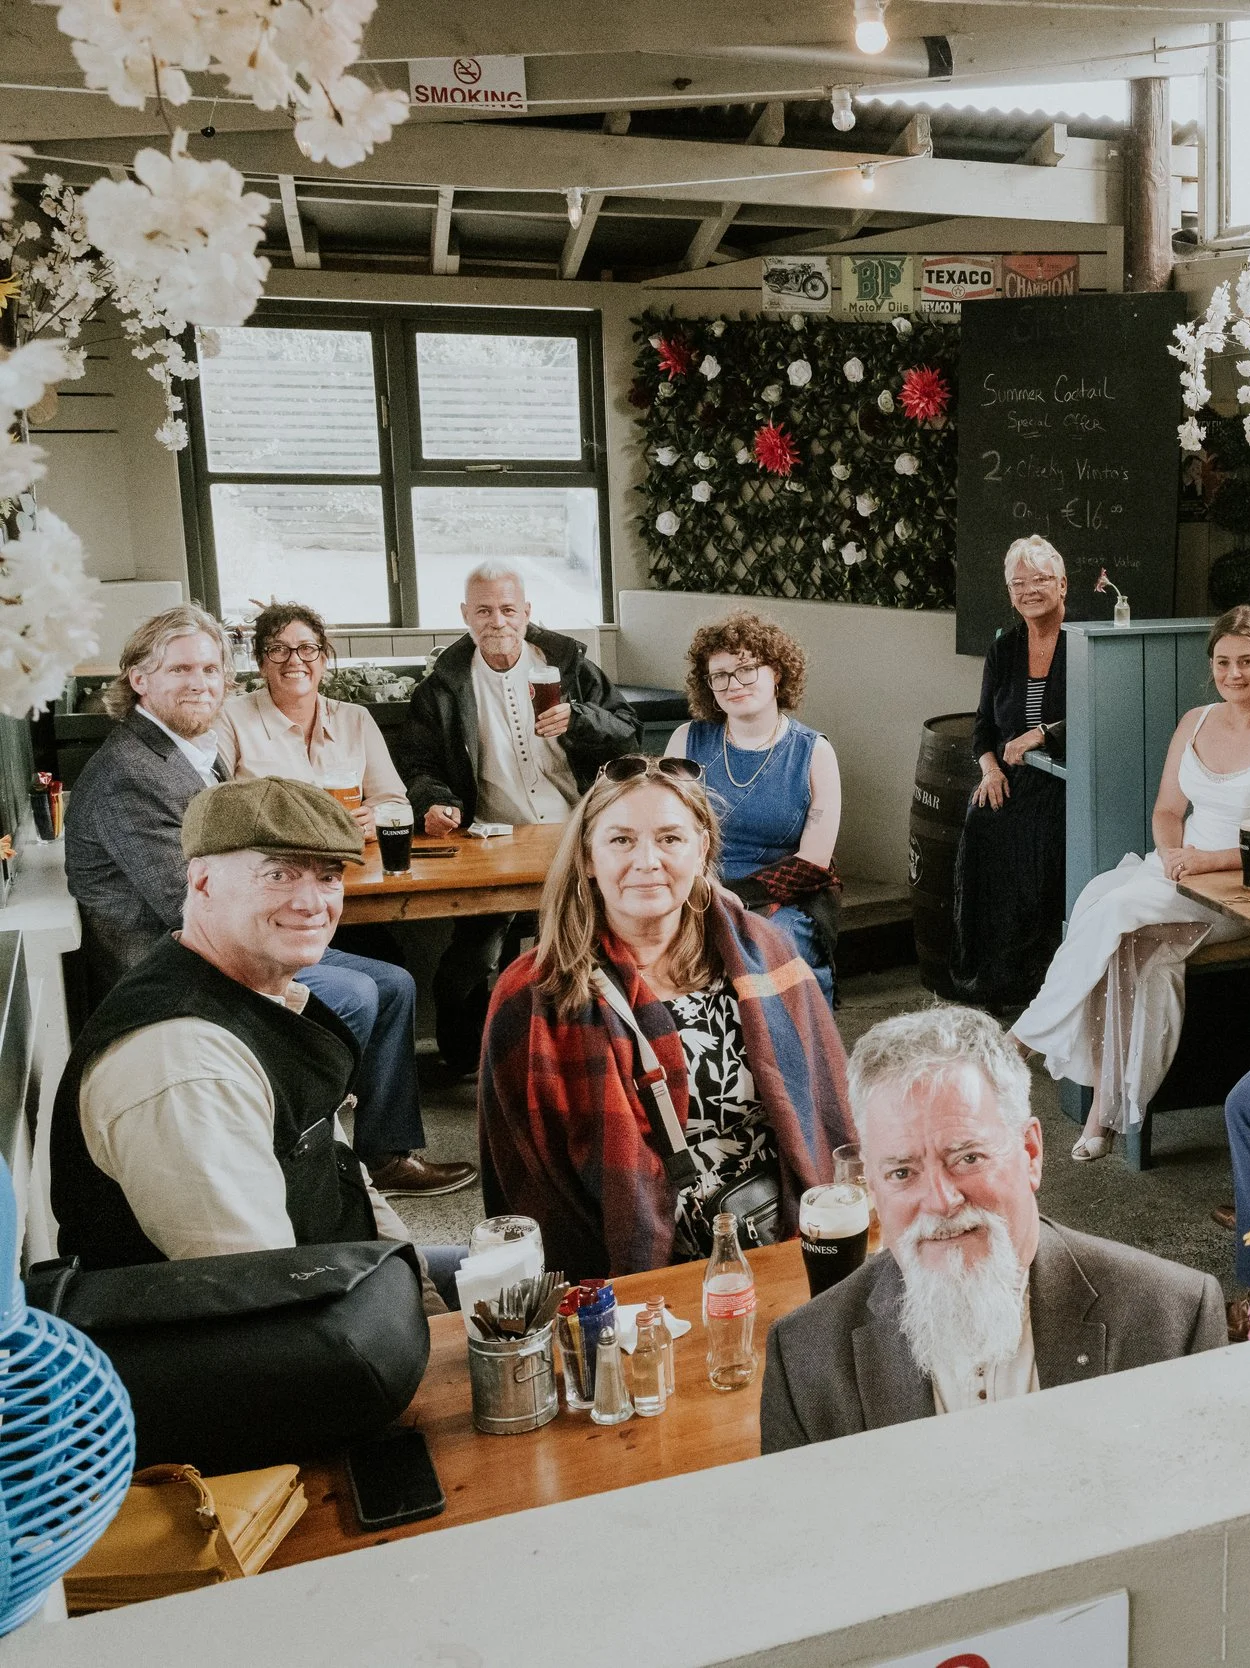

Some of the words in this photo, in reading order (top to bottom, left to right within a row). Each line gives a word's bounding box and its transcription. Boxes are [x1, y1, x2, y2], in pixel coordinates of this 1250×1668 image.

[415, 85, 523, 109] SMOKING
[851, 259, 902, 301] BP
[925, 270, 992, 285] TEXACO
[1005, 270, 1075, 299] CHAMPION
[849, 302, 881, 313] Motor
[888, 302, 909, 313] Oils
[921, 301, 951, 313] TEXACO
[922, 790, 941, 810] BAR
[382, 828, 410, 837] GUINNESS
